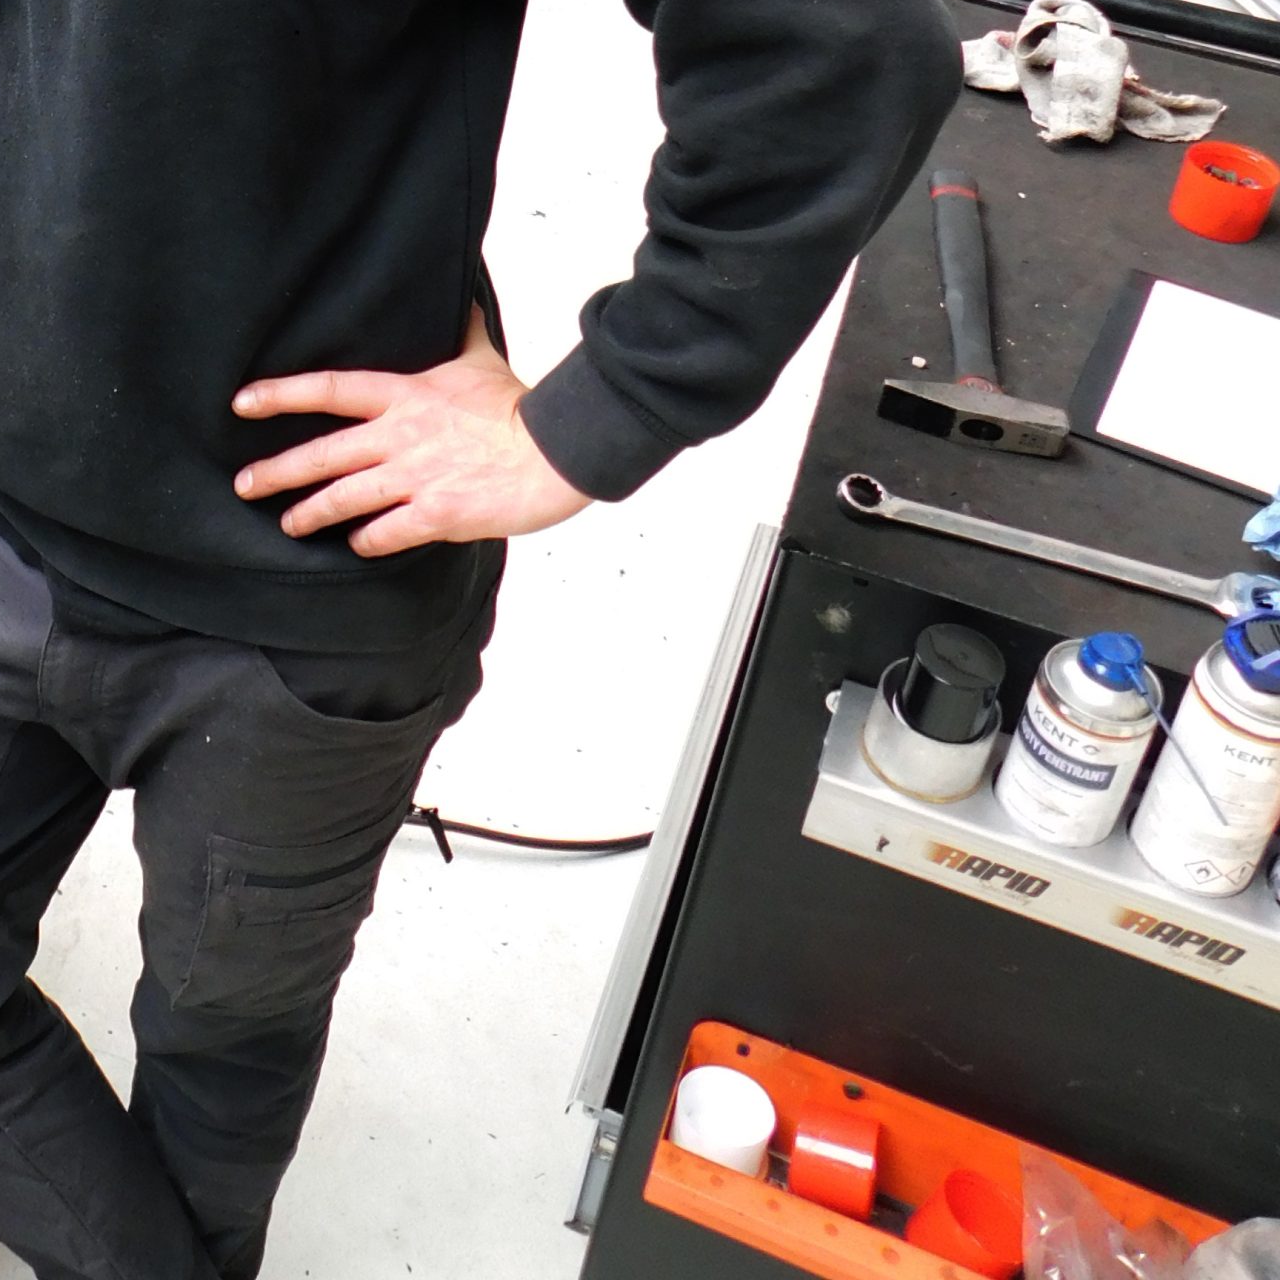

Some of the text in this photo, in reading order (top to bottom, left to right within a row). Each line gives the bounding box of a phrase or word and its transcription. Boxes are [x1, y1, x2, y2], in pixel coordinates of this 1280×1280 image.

[1034, 704, 1080, 747] KENT
[1038, 745, 1110, 782] PENETRANT
[1224, 744, 1278, 767] KENT
[926, 840, 1052, 898] RAPID
[1111, 906, 1247, 966] RAPID
